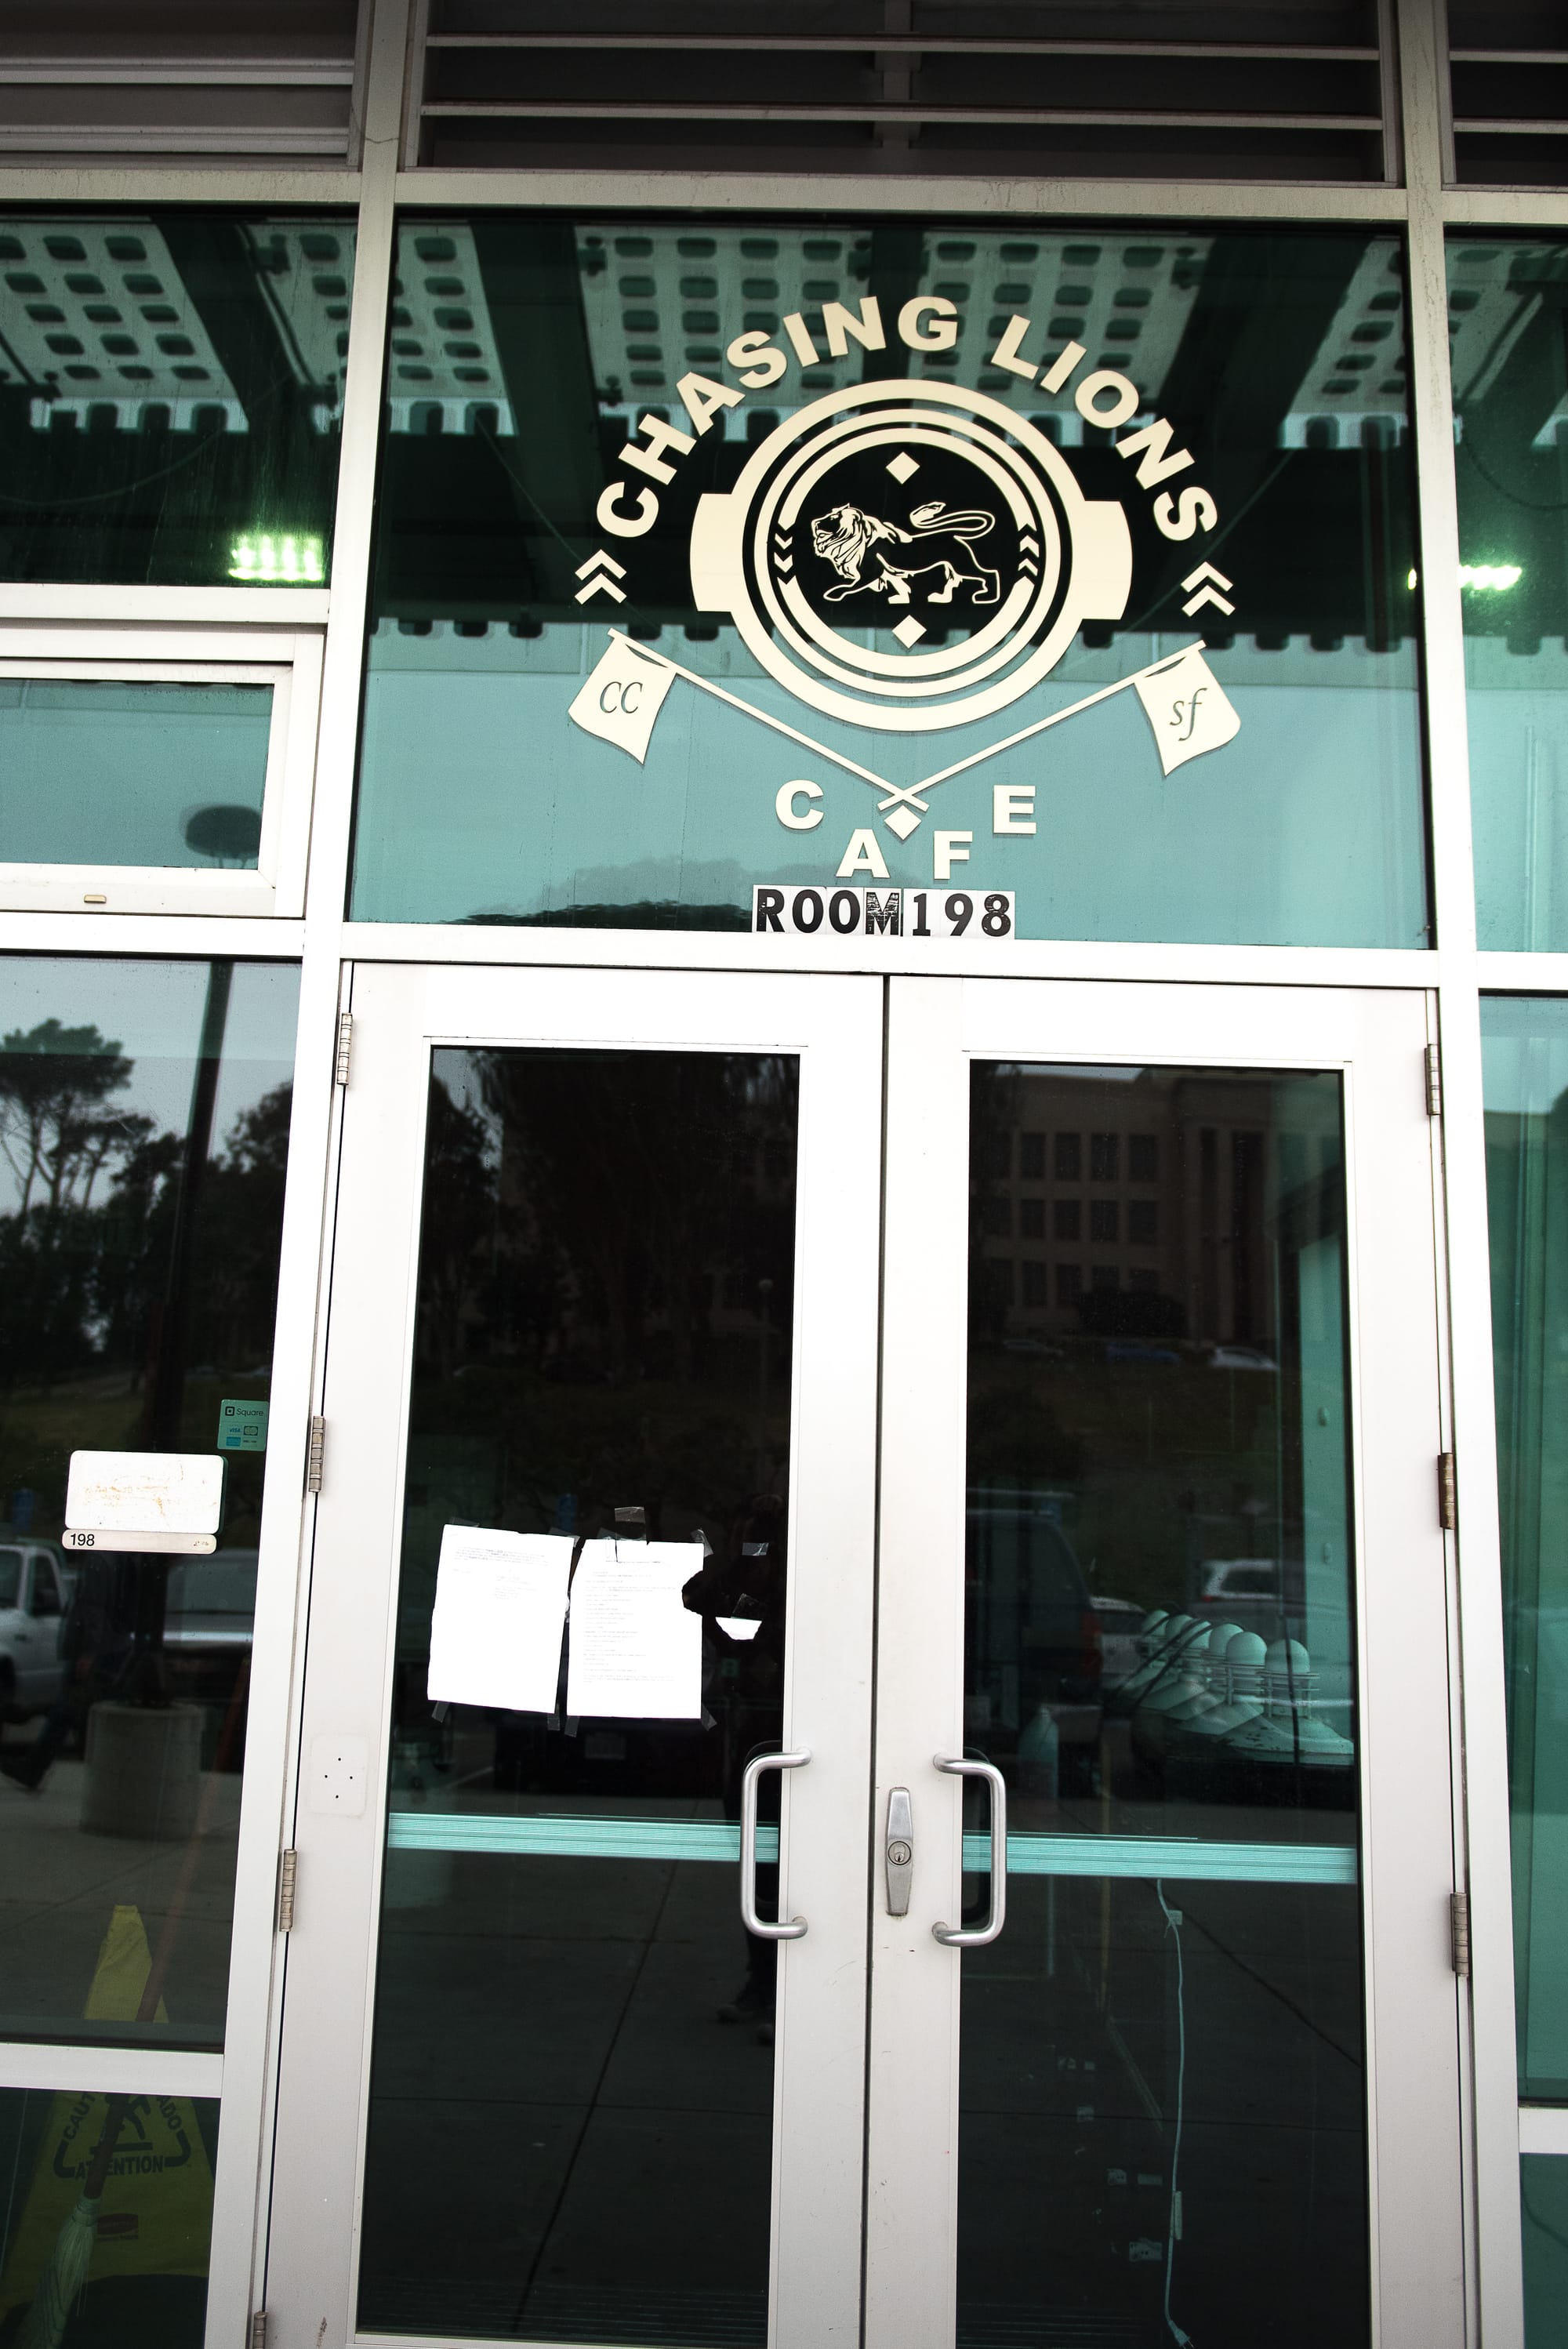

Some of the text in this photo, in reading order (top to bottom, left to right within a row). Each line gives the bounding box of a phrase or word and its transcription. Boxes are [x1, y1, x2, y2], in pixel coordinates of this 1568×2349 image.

[596, 296, 1218, 541] CHASING LIONS
[599, 681, 644, 714] CC
[1169, 687, 1208, 742] sf
[775, 779, 1037, 880] CAFE
[236, 1407, 264, 1417] Square
[70, 1533, 95, 1547] 198
[75, 2155, 164, 2180] AENTION
